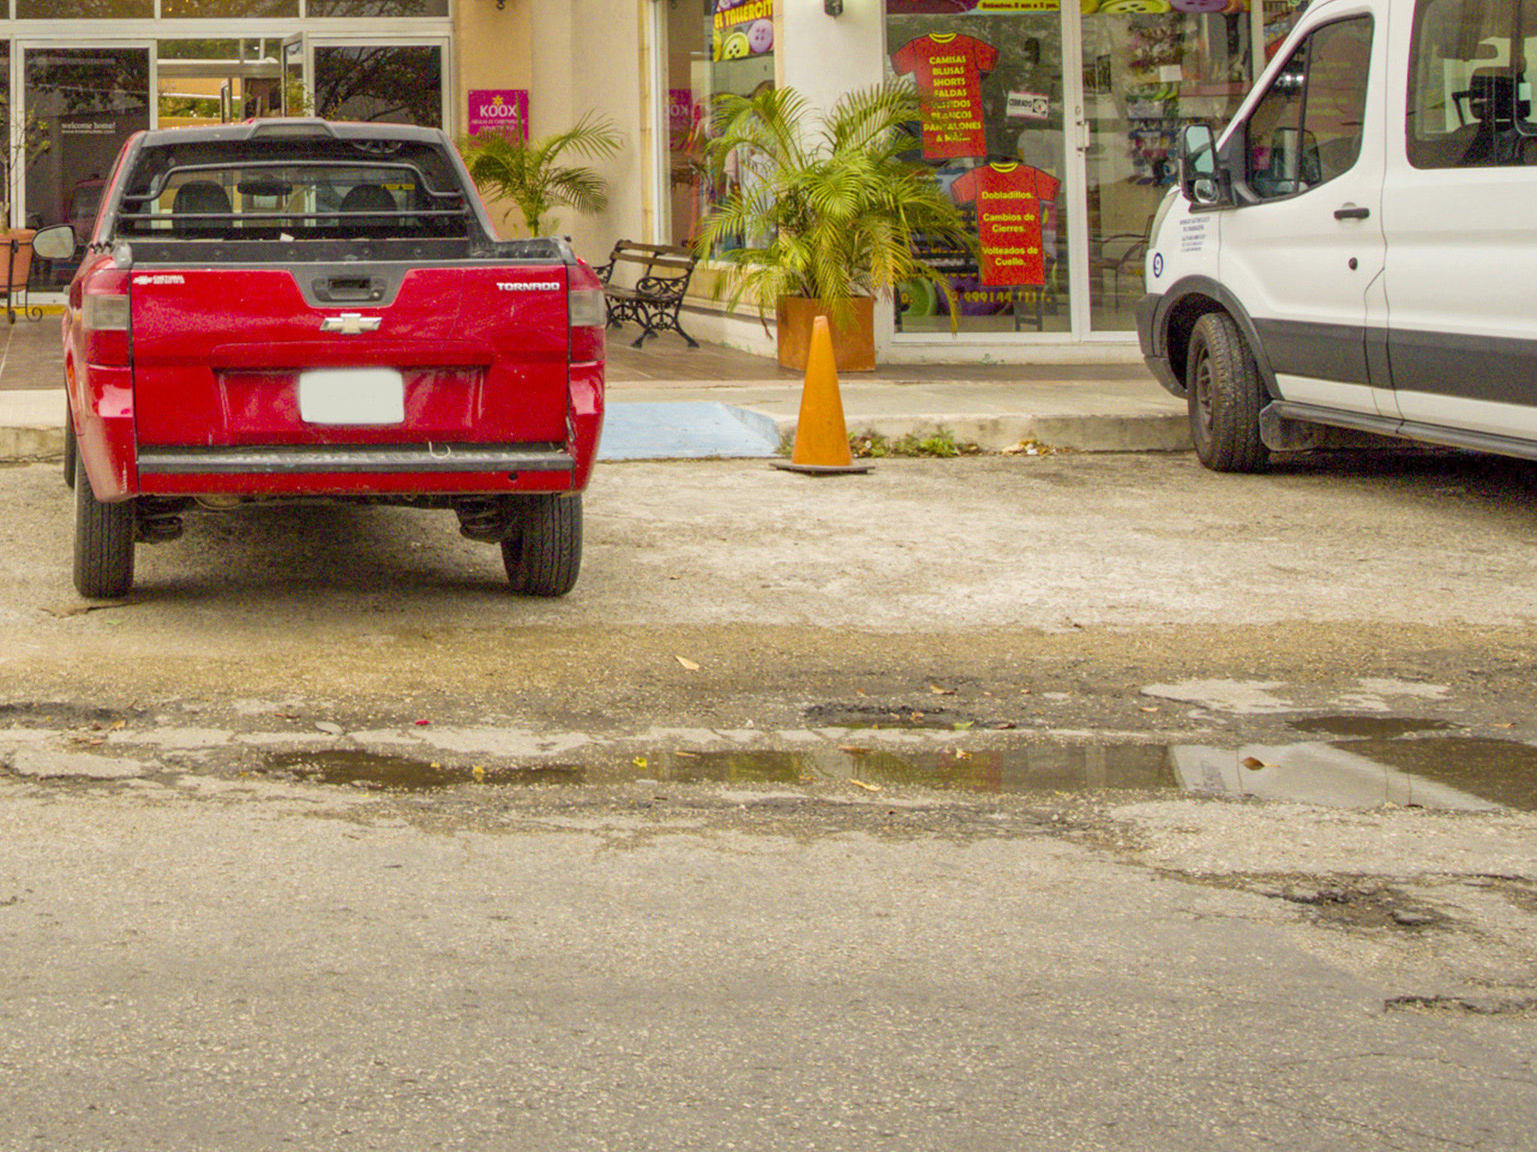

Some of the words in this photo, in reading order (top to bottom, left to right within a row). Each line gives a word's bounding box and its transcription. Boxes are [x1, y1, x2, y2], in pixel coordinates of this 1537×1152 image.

[713, 12, 724, 29] EL
[929, 55, 967, 65] CAMISAS
[932, 66, 965, 76] BLUSAS
[933, 77, 966, 87] SHORTS
[479, 104, 518, 118] KOOX
[923, 121, 982, 132] PANALONES
[981, 191, 1034, 200] Dobladillos.
[983, 213, 1022, 222] Cambios
[1023, 213, 1036, 222] de
[991, 224, 1027, 233] Cierres.
[982, 246, 1025, 255] Volteados
[1027, 246, 1039, 255] de
[995, 257, 1027, 266] Cuello.
[496, 282, 561, 291] TORNADO
